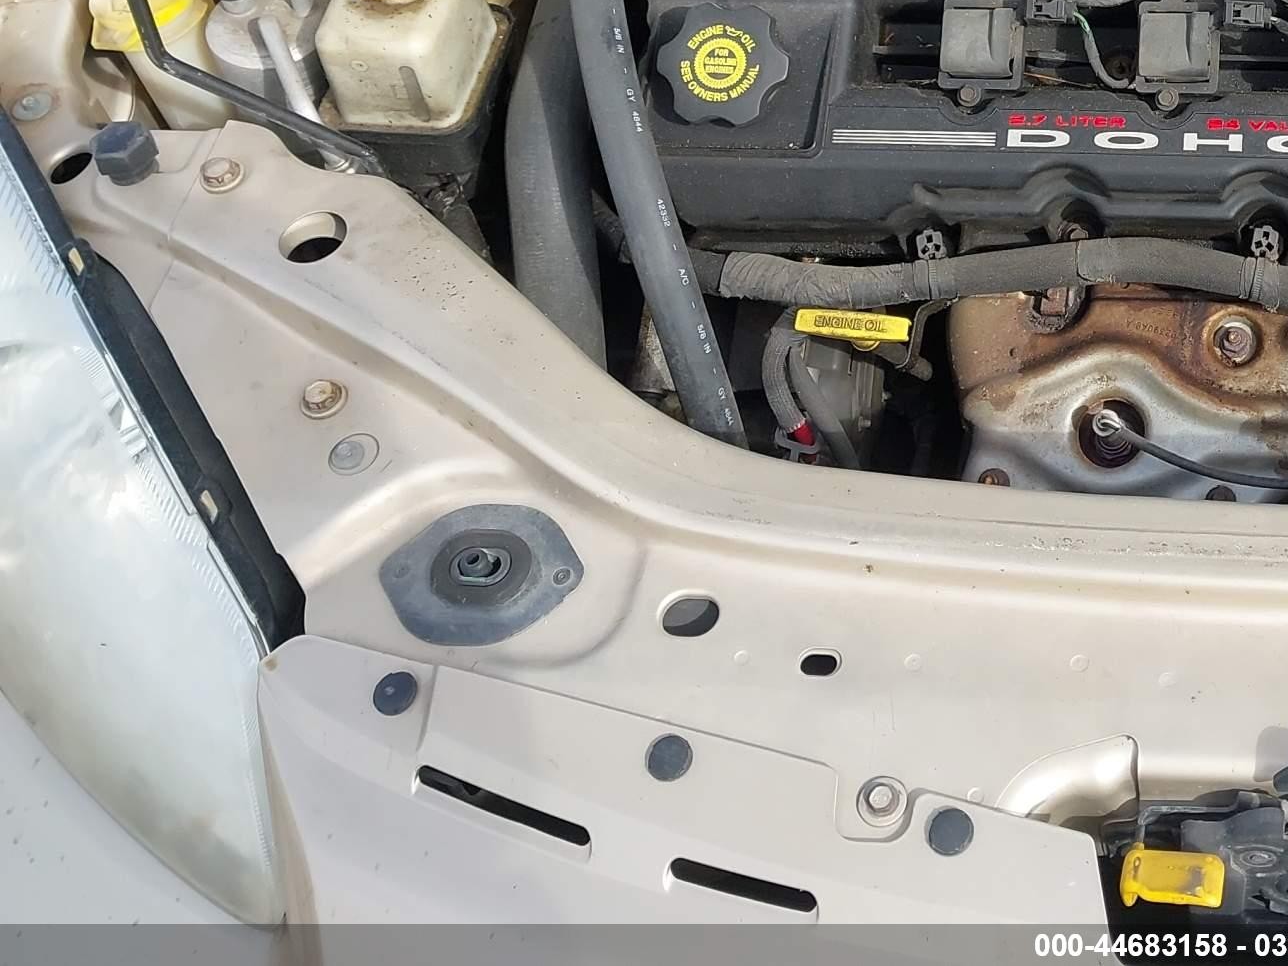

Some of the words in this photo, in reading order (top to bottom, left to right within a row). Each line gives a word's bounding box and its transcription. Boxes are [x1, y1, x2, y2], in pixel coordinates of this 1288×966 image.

[688, 24, 724, 50] ENGINE
[741, 34, 756, 53] OIL
[715, 48, 729, 56] FOR
[681, 60, 691, 82] SEE
[688, 82, 728, 102] OWNERS
[729, 64, 759, 99] MANUAL
[1008, 114, 1048, 126] 2.7
[1056, 116, 1126, 128] LITER
[1207, 118, 1240, 130] 24
[678, 268, 690, 286] A/C
[718, 388, 726, 400] GY
[815, 314, 864, 330] ENGINE
[865, 319, 887, 332] OIL
